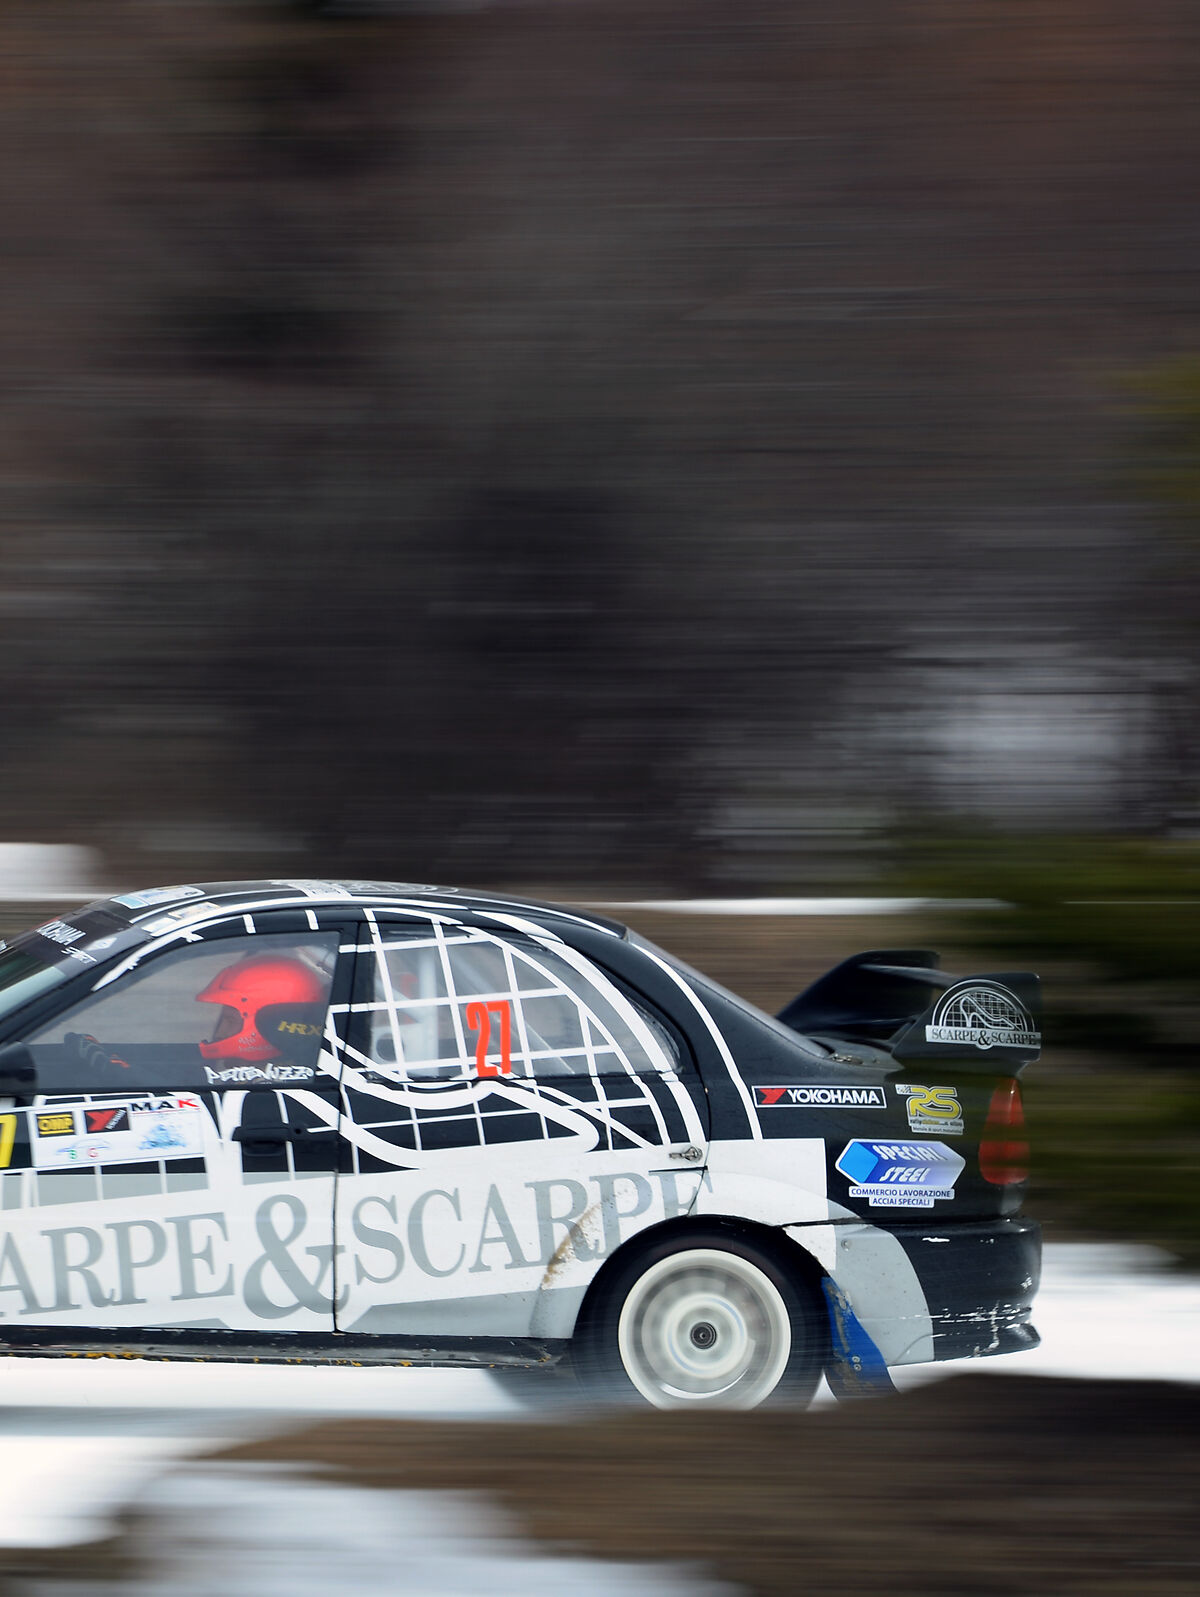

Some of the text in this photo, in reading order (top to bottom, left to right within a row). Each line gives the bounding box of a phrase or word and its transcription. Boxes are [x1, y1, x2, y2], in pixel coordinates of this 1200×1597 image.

[277, 1021, 322, 1036] HRX
[465, 1000, 511, 1077] 27
[787, 1089, 881, 1104] YOKOHAMA
[129, 1098, 200, 1112] MAK
[38, 1117, 73, 1131] OMP
[871, 1144, 948, 1161] SPECIAL
[879, 1166, 931, 1182] STEEL
[851, 1188, 951, 1198] COMMERCIO LAVORAZIONE
